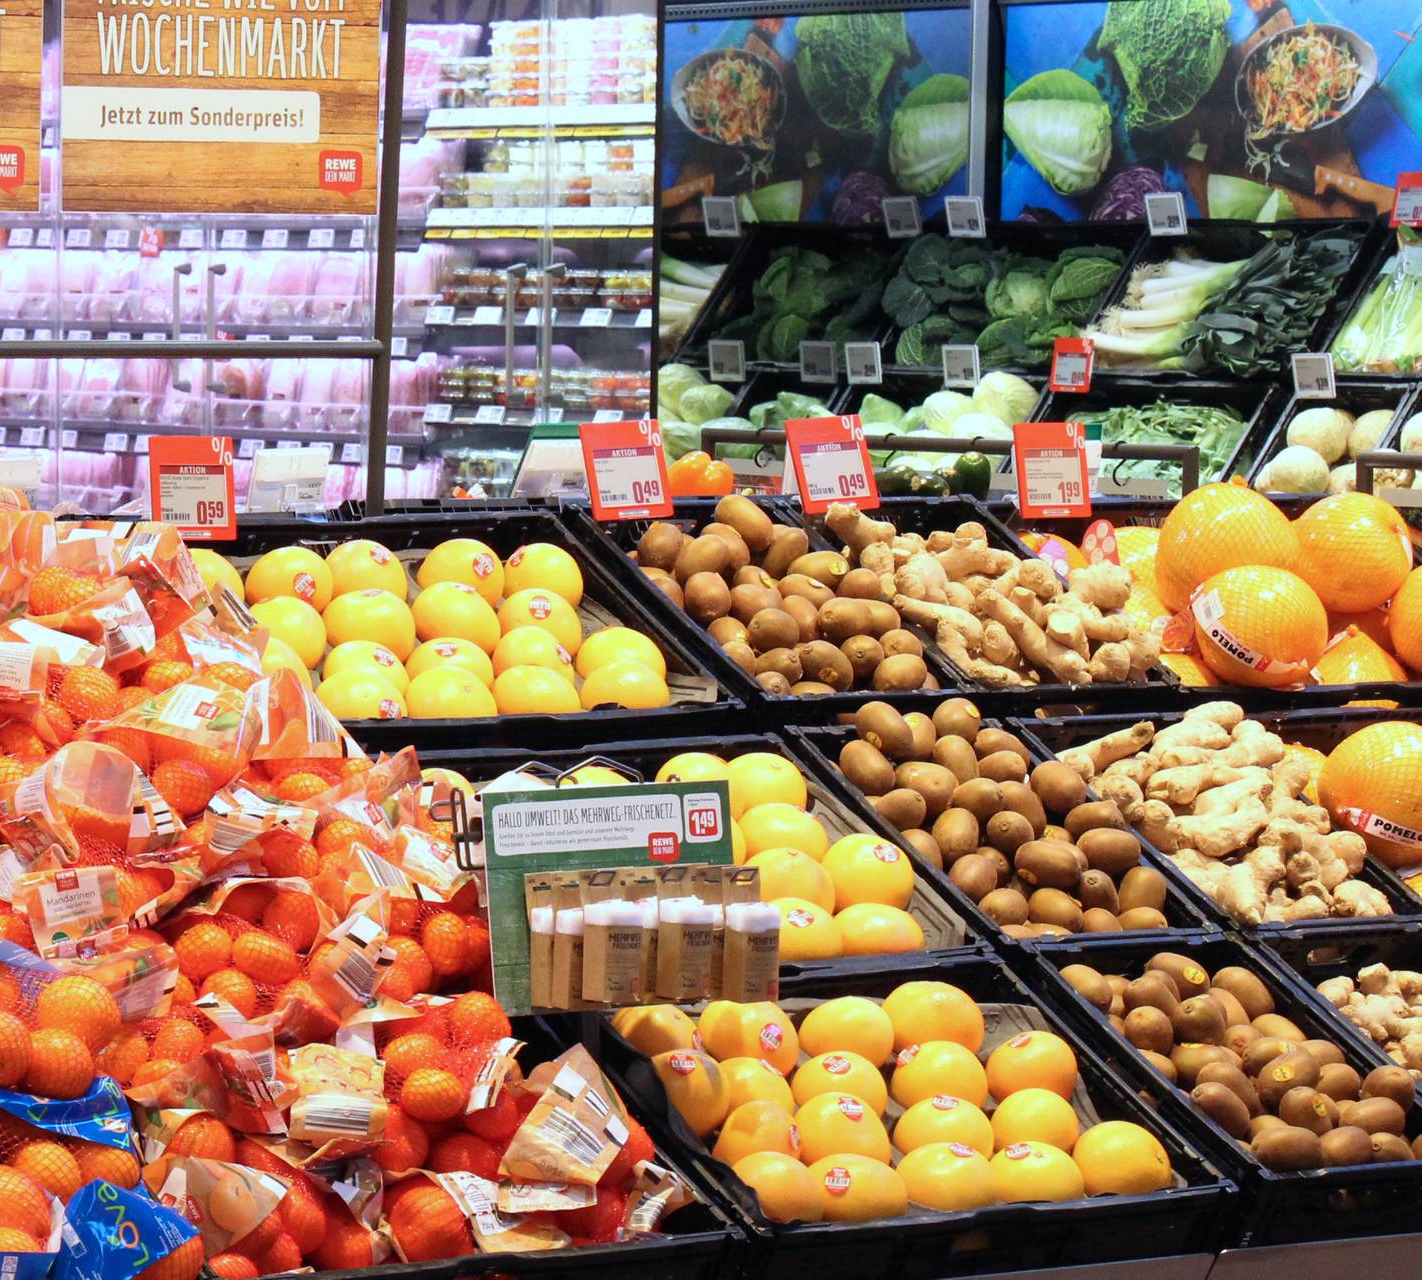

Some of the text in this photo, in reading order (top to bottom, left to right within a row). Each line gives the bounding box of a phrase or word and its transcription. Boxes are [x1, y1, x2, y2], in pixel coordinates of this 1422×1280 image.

[96, 11, 346, 79] WOCHENMARKT
[101, 105, 304, 131] Jetzt zum Sonderpreis!
[0, 166, 18, 178] MARKT
[325, 159, 356, 170] REWE
[325, 171, 356, 183] DEIN MARKT
[611, 448, 638, 457] AKTION
[1040, 449, 1064, 458] AKTION
[179, 466, 207, 474] AKTION
[631, 479, 660, 504] 0.49
[837, 473, 865, 497] 0.49
[1058, 480, 1081, 503] 1.99
[196, 500, 225, 525] 0.59
[1211, 628, 1255, 666] POMELO
[498, 811, 522, 829] HALLO
[524, 809, 561, 828] UMWELT!
[563, 808, 579, 825] DAS
[691, 811, 715, 835] 1.49
[652, 837, 674, 846] REWE
